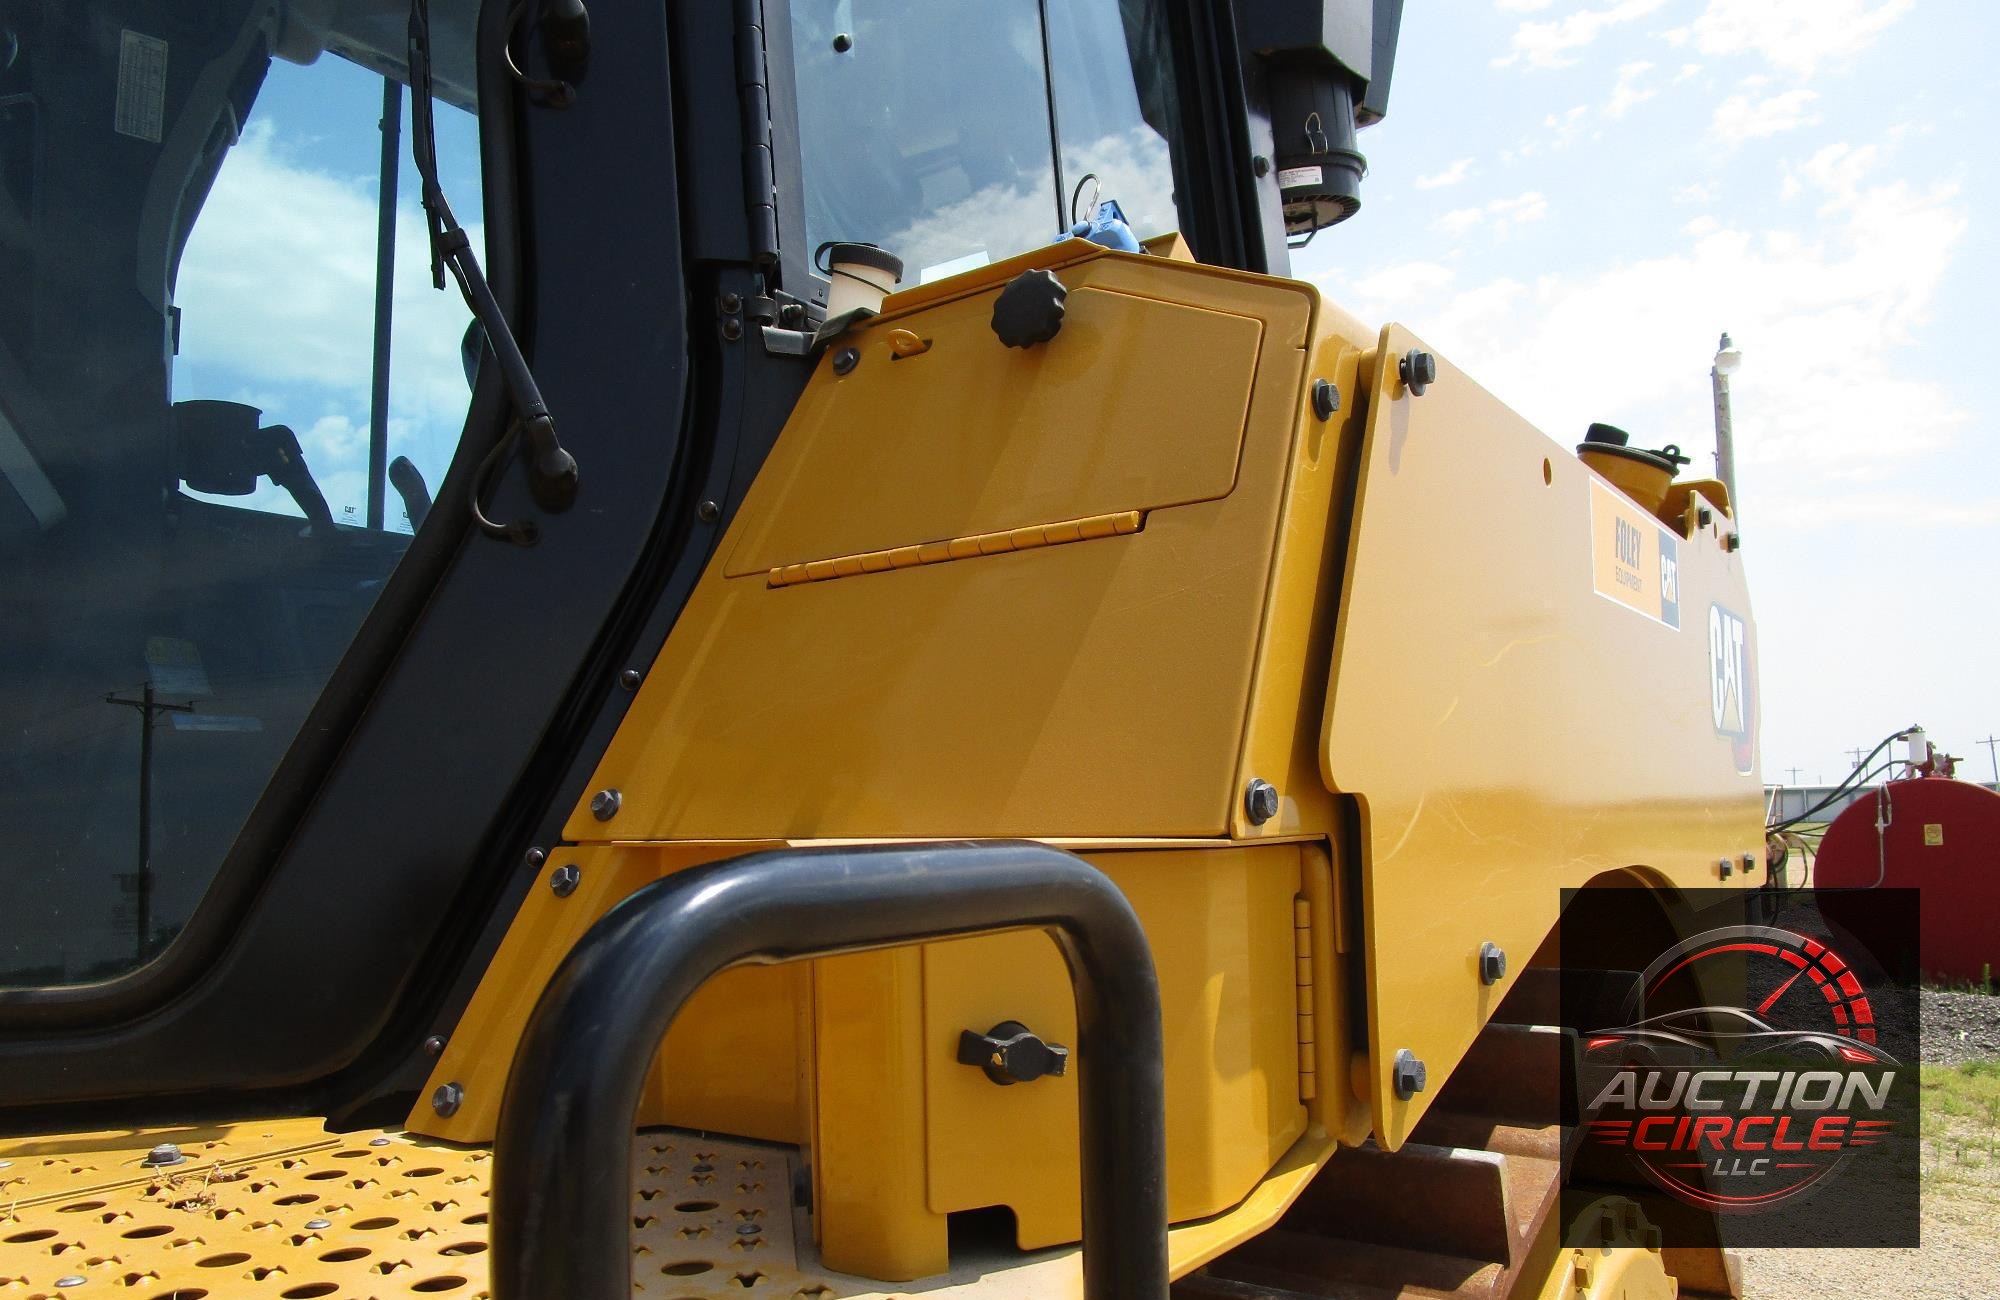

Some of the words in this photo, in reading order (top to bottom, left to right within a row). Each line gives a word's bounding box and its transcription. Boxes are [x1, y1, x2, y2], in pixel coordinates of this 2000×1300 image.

[1615, 515, 1642, 570] FOLEY
[1615, 566, 1642, 592] EQUIPMENT
[1661, 554, 1677, 604] CAT
[1709, 605, 1744, 732] CAT
